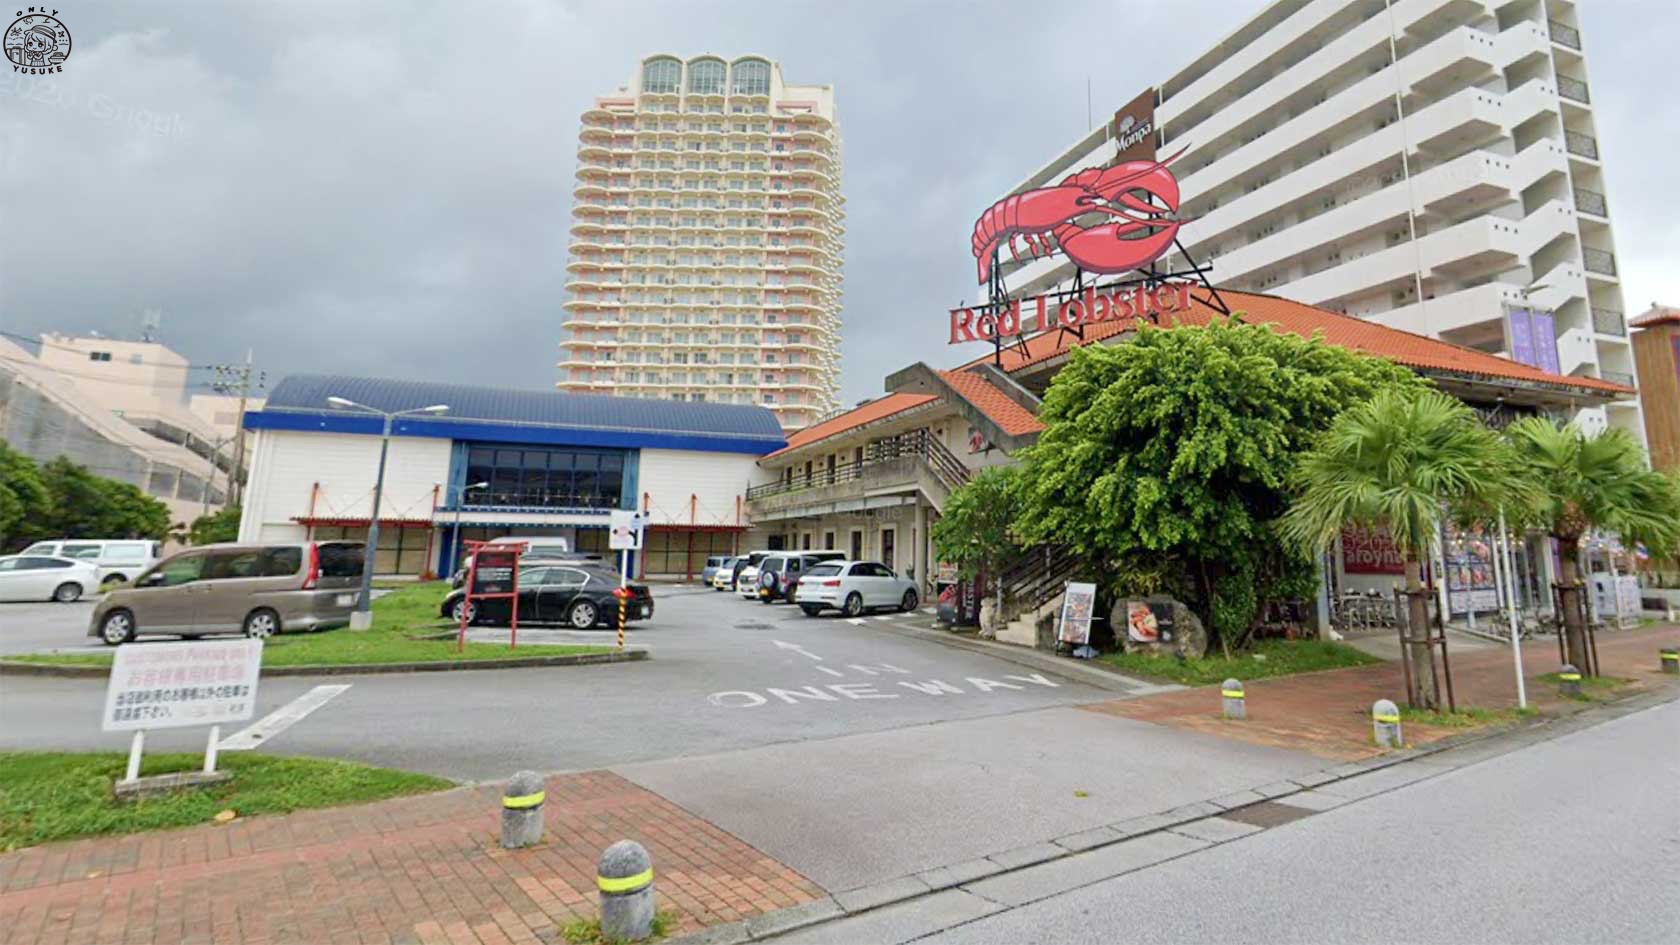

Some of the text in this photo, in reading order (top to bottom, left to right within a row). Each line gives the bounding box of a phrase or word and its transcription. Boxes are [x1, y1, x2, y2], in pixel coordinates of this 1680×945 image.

[948, 280, 1198, 344] Red Lobster
[706, 673, 1061, 708] ONE WAY
